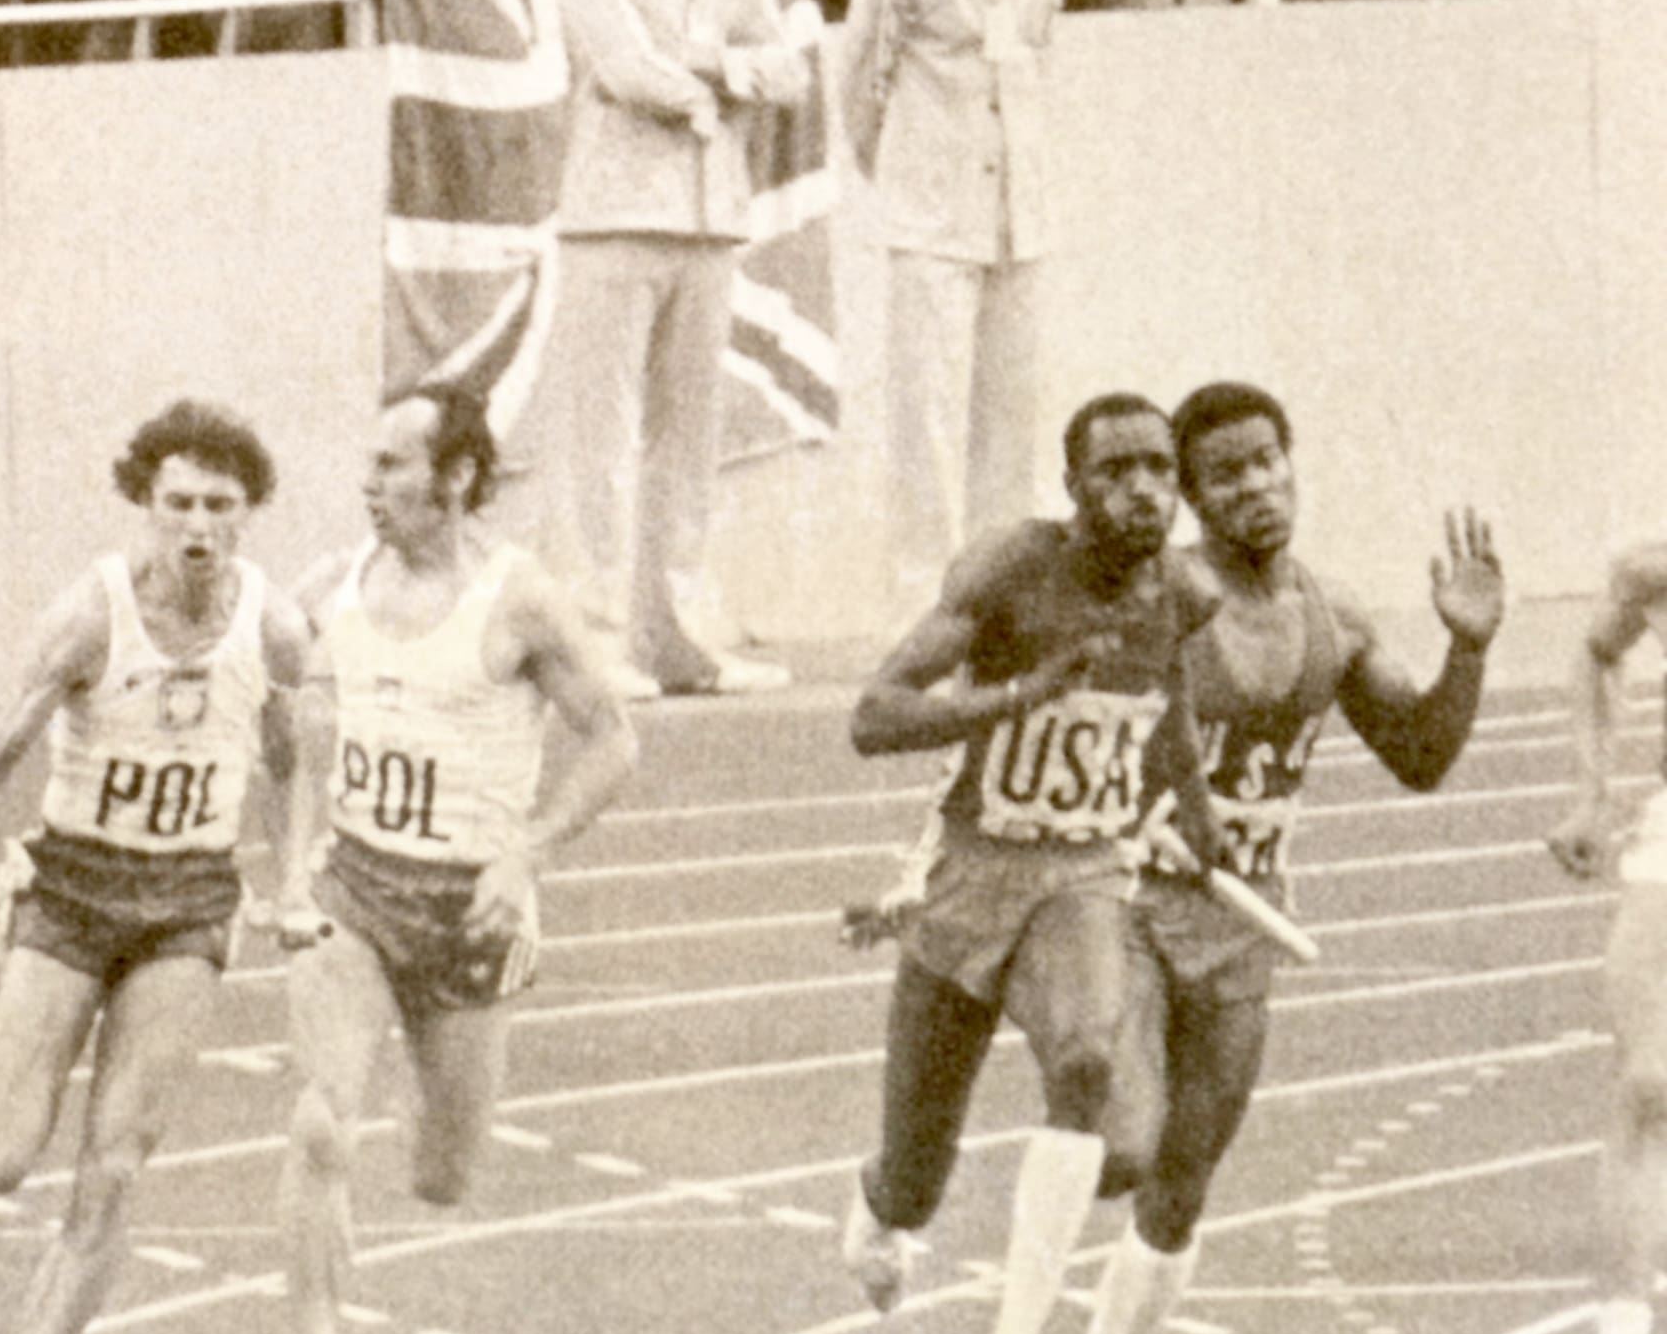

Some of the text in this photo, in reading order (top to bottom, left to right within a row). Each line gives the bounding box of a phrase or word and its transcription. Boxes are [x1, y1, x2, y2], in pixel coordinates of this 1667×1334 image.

[94, 757, 219, 837] POL
[337, 737, 451, 843] POL
[1000, 716, 1133, 812] USA
